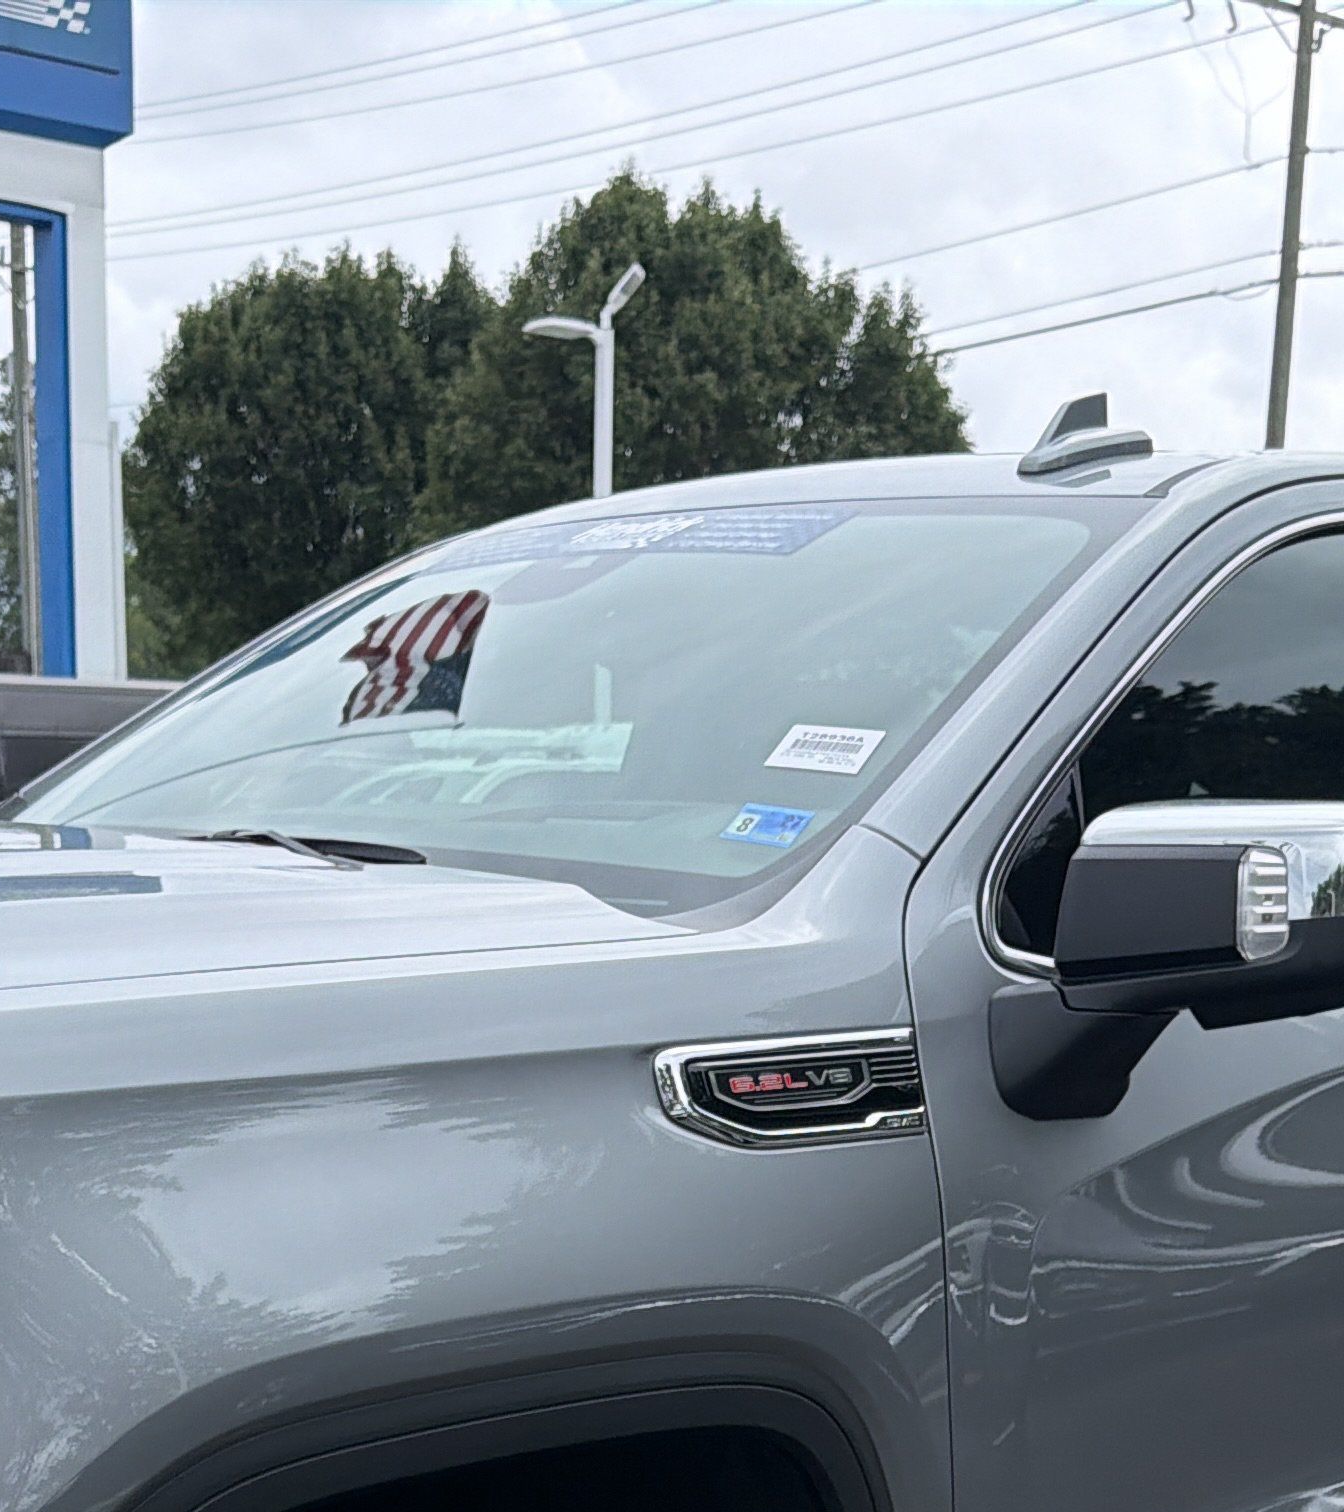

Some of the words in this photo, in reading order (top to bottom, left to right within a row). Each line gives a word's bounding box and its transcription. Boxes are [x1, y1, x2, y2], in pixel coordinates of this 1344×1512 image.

[736, 817, 755, 833] 8
[728, 1072, 808, 1095] 6.2L
[806, 1066, 853, 1087] V8
